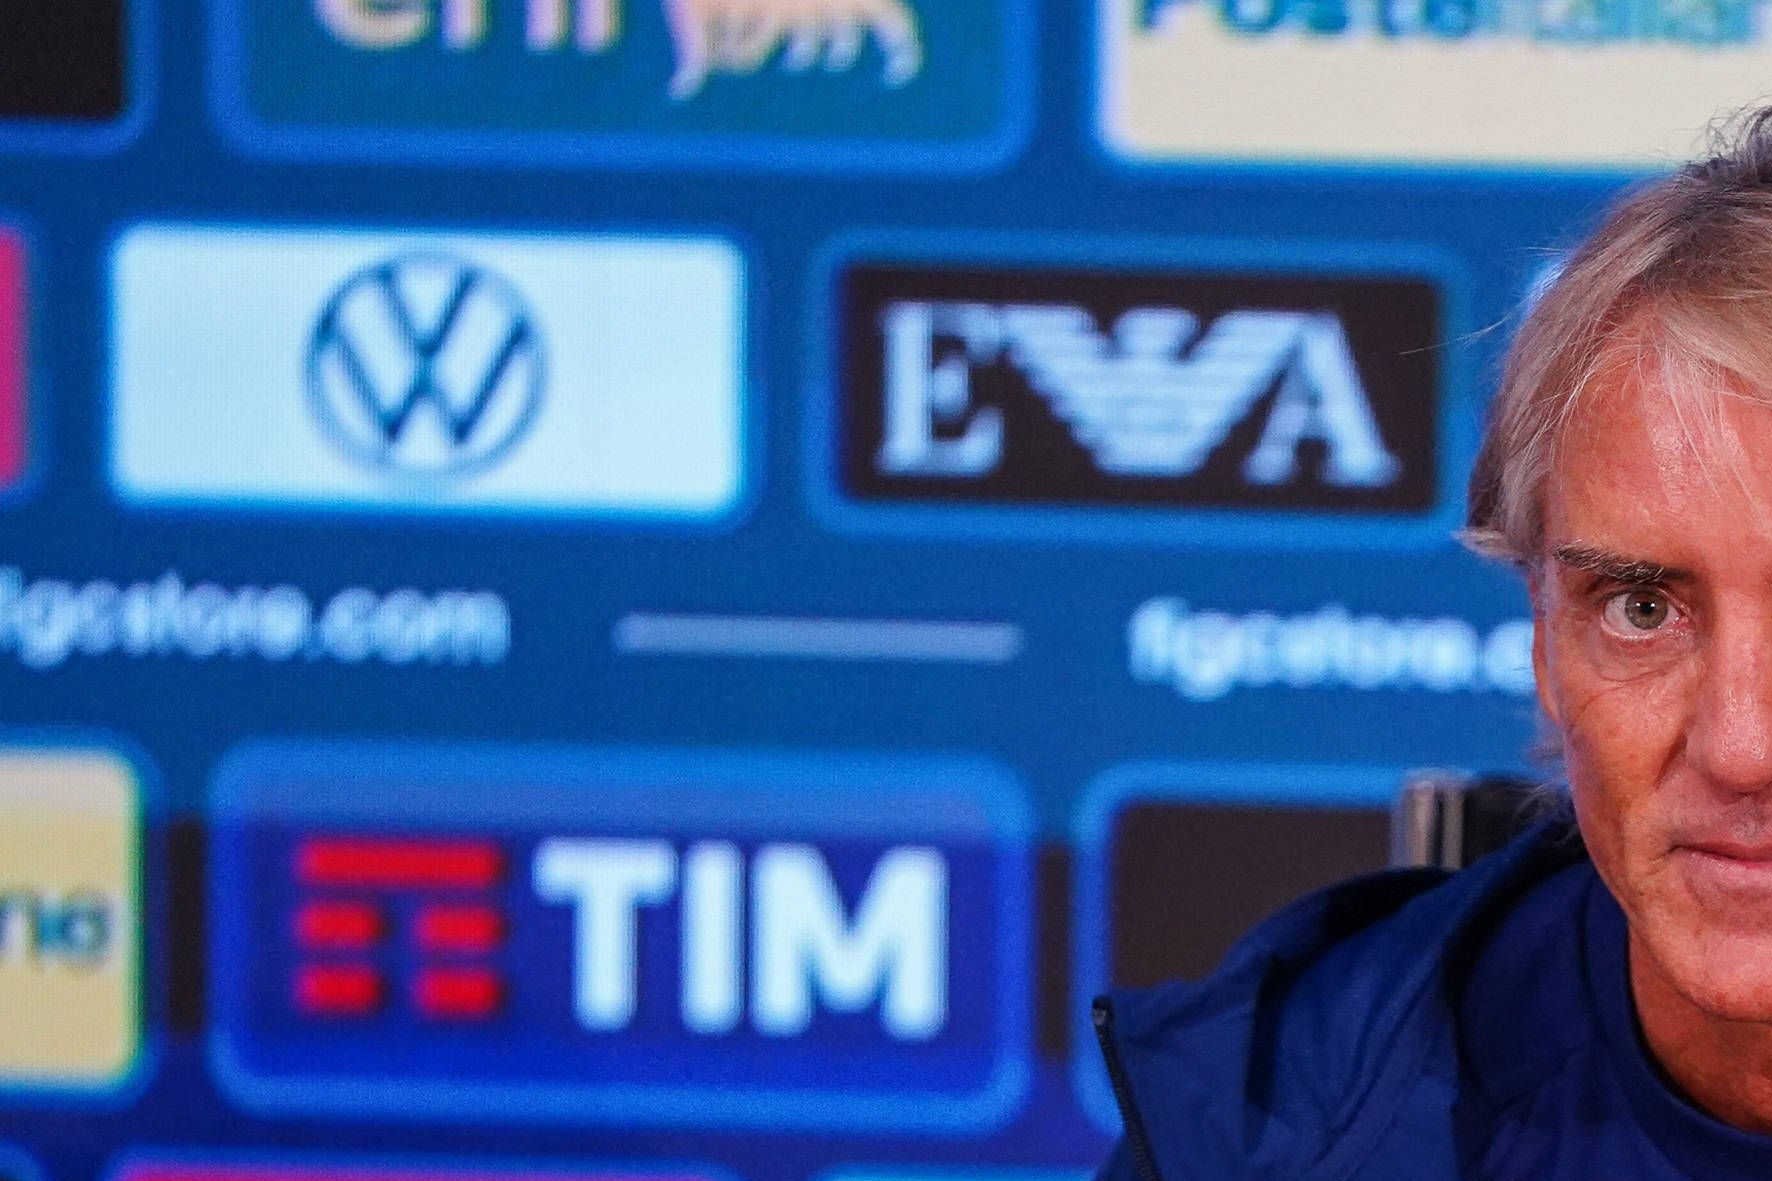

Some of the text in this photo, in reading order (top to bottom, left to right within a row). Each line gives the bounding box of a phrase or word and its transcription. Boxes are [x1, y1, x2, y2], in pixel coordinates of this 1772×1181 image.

[0, 566, 510, 668] igcstore.com
[1128, 597, 1534, 700] figcstore.c
[532, 838, 950, 1040] TIM
